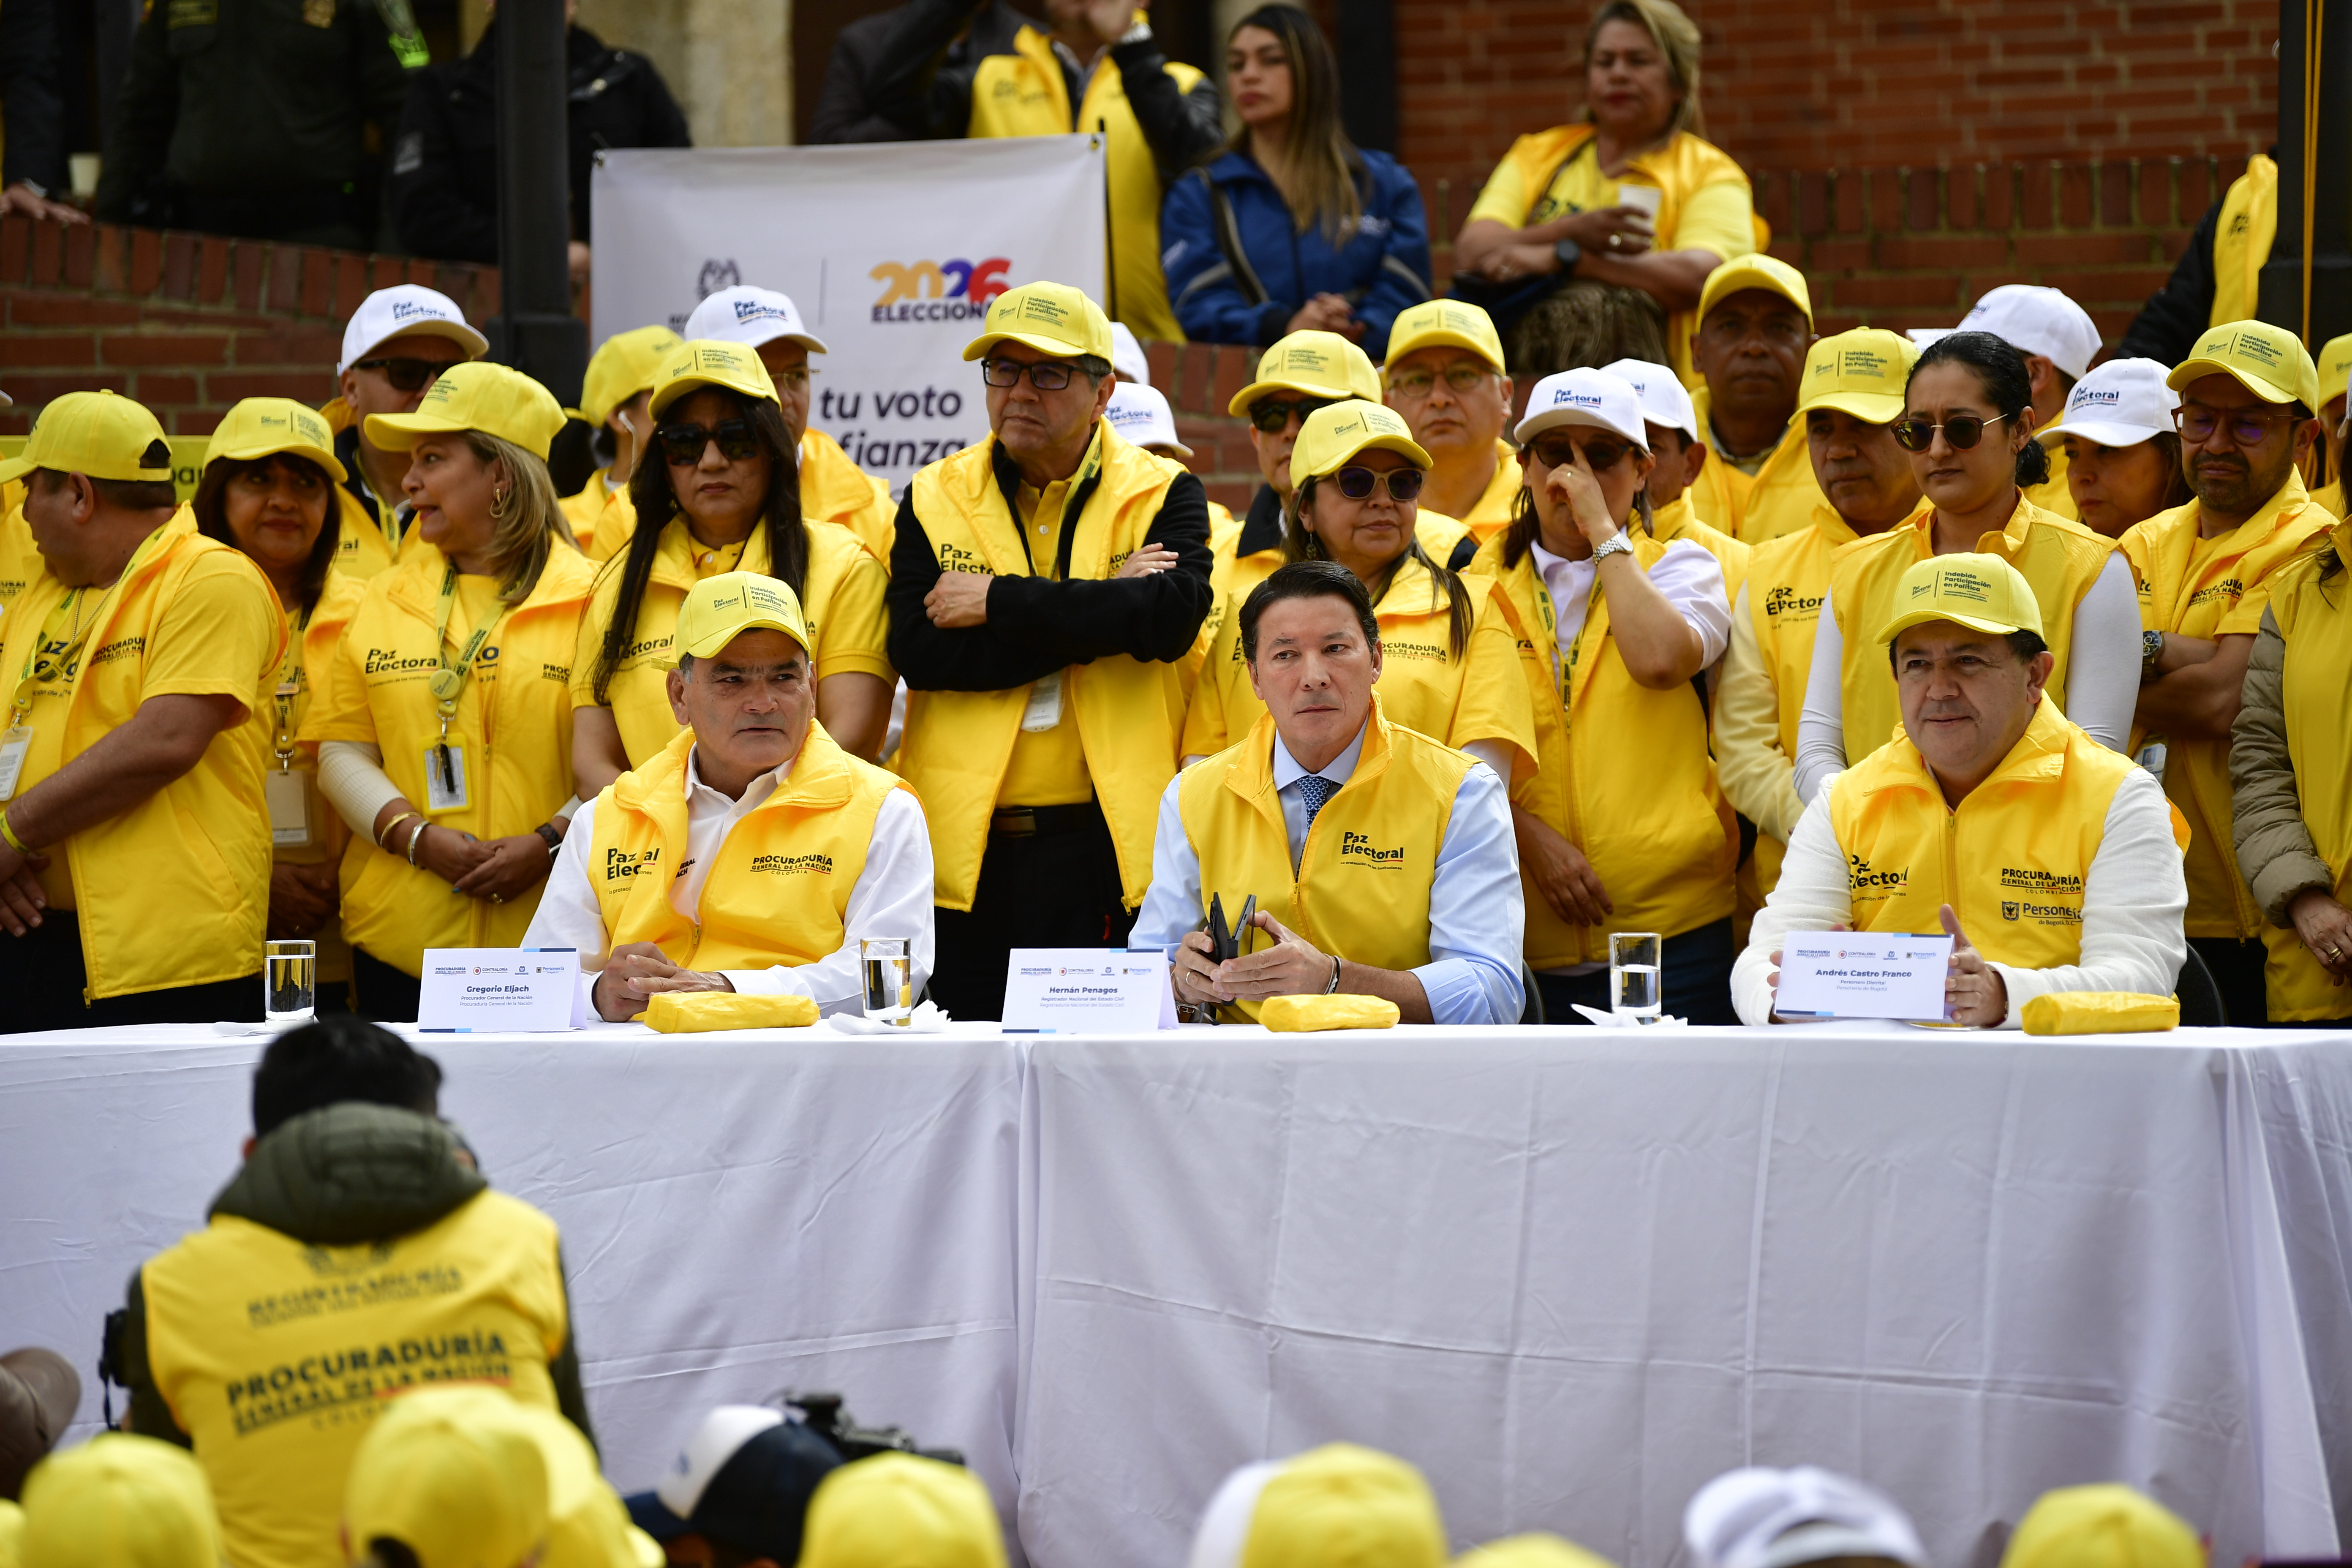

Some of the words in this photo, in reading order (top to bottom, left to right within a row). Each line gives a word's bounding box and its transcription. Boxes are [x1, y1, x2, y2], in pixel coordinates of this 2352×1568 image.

[870, 258, 1012, 305] 2026
[735, 300, 755, 309] Paz
[1028, 296, 1056, 305] Indebida
[737, 305, 786, 318] Electoral
[871, 302, 992, 321] ELECCION
[1027, 301, 1068, 315] Participación
[1034, 307, 1058, 317] Política
[2243, 333, 2270, 346] Indebida
[2240, 338, 2283, 357] Participación
[2249, 344, 2272, 357] Política
[820, 386, 860, 419] tu
[874, 385, 962, 417] voto
[1554, 395, 1601, 404] Electoral
[940, 543, 973, 559] Paz
[1945, 571, 1977, 579] Indebida
[1912, 583, 1932, 596] Electoral
[1944, 577, 1991, 589] Participación
[1954, 583, 1981, 592] Política
[750, 586, 776, 596] Indebida
[714, 596, 739, 608] Electoral
[751, 590, 788, 606] Participación
[760, 596, 782, 607] Política
[367, 647, 397, 661] Paz
[1382, 642, 1447, 657] OCURADURÍA
[1421, 652, 1446, 662] NACIÓN
[365, 657, 437, 674] Electora
[1343, 831, 1368, 844] Paz
[607, 848, 637, 865] Paz
[1342, 844, 1404, 860] Electoral
[753, 854, 833, 866] PROCURADURÍA
[805, 862, 832, 872] NACIÓN
[2001, 878, 2033, 886] GENERAL
[2002, 868, 2080, 886] PROCURAURÍA
[466, 985, 502, 994] Gregorio
[504, 985, 529, 994] Eljach
[226, 1328, 507, 1406] PROCURADURÍA
